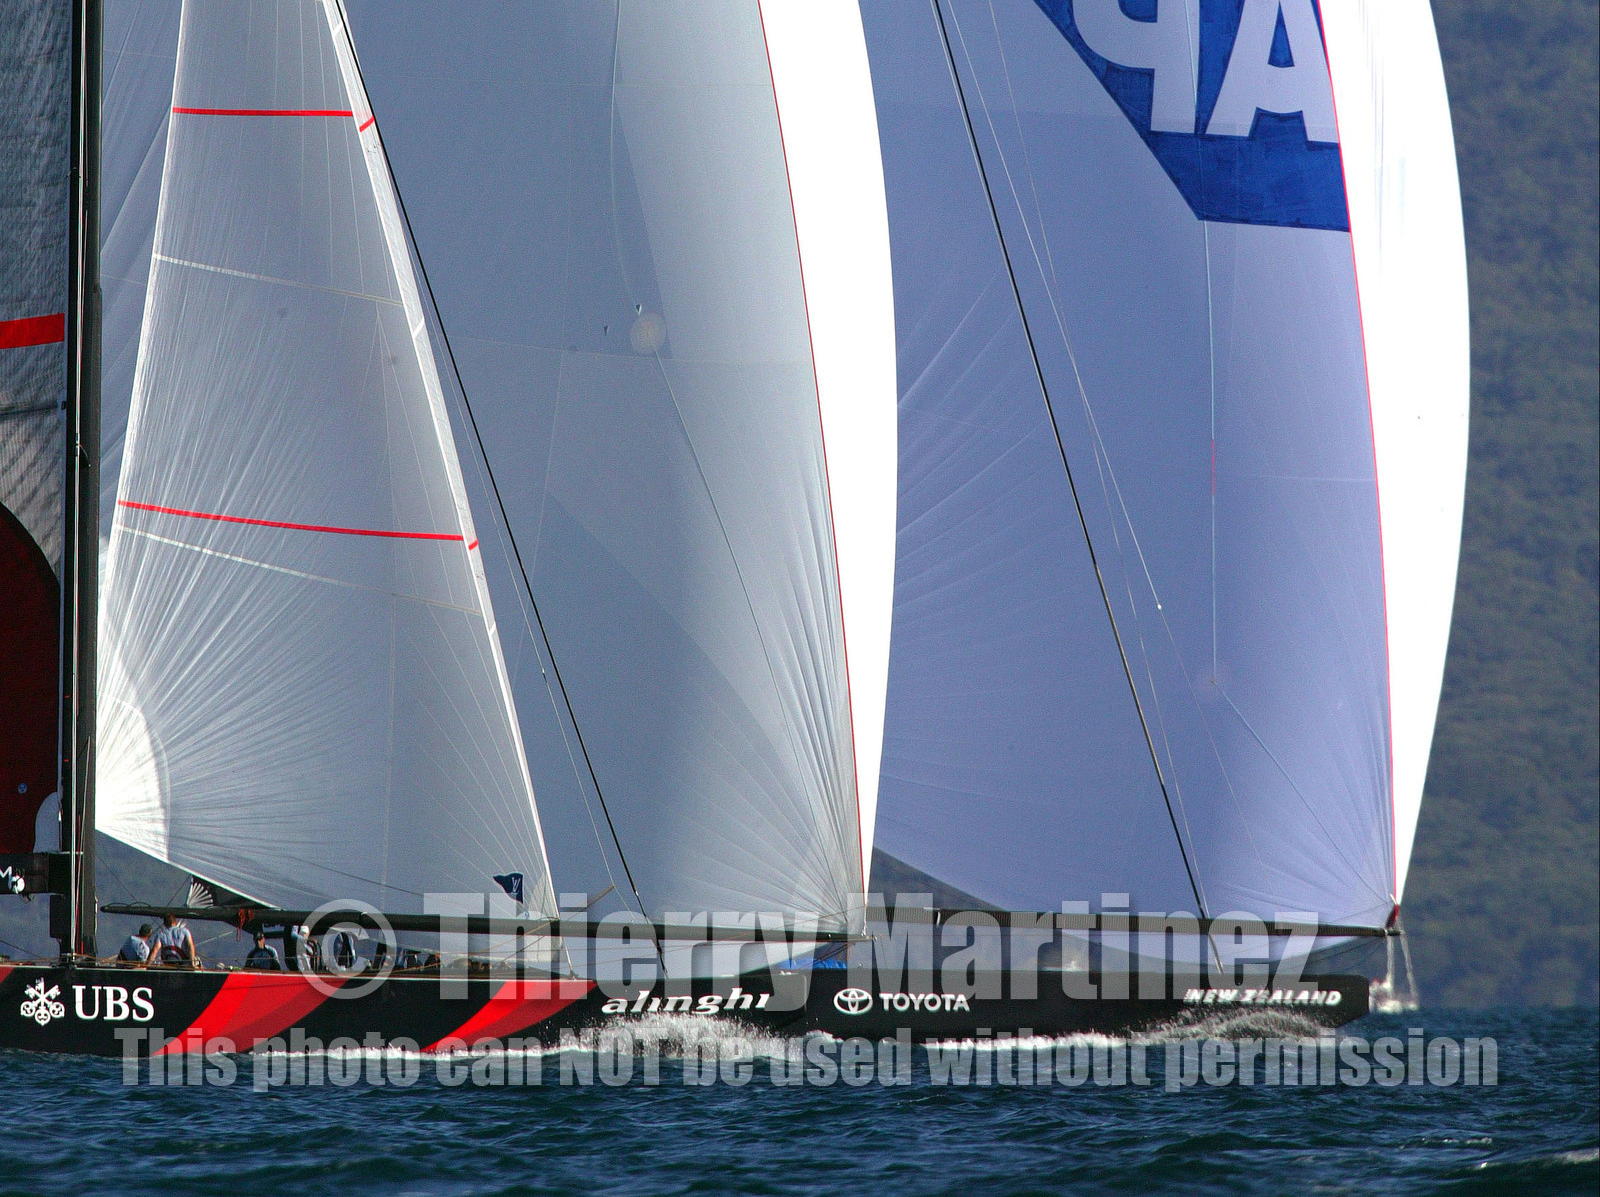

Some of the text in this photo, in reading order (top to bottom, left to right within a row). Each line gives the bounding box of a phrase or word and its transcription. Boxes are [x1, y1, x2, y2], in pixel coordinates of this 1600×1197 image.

[72, 985, 154, 1022] UBS
[601, 987, 770, 1015] alinghi
[879, 993, 970, 1012] TOYOTA
[1184, 989, 1342, 1006] NEW ZEALAND
